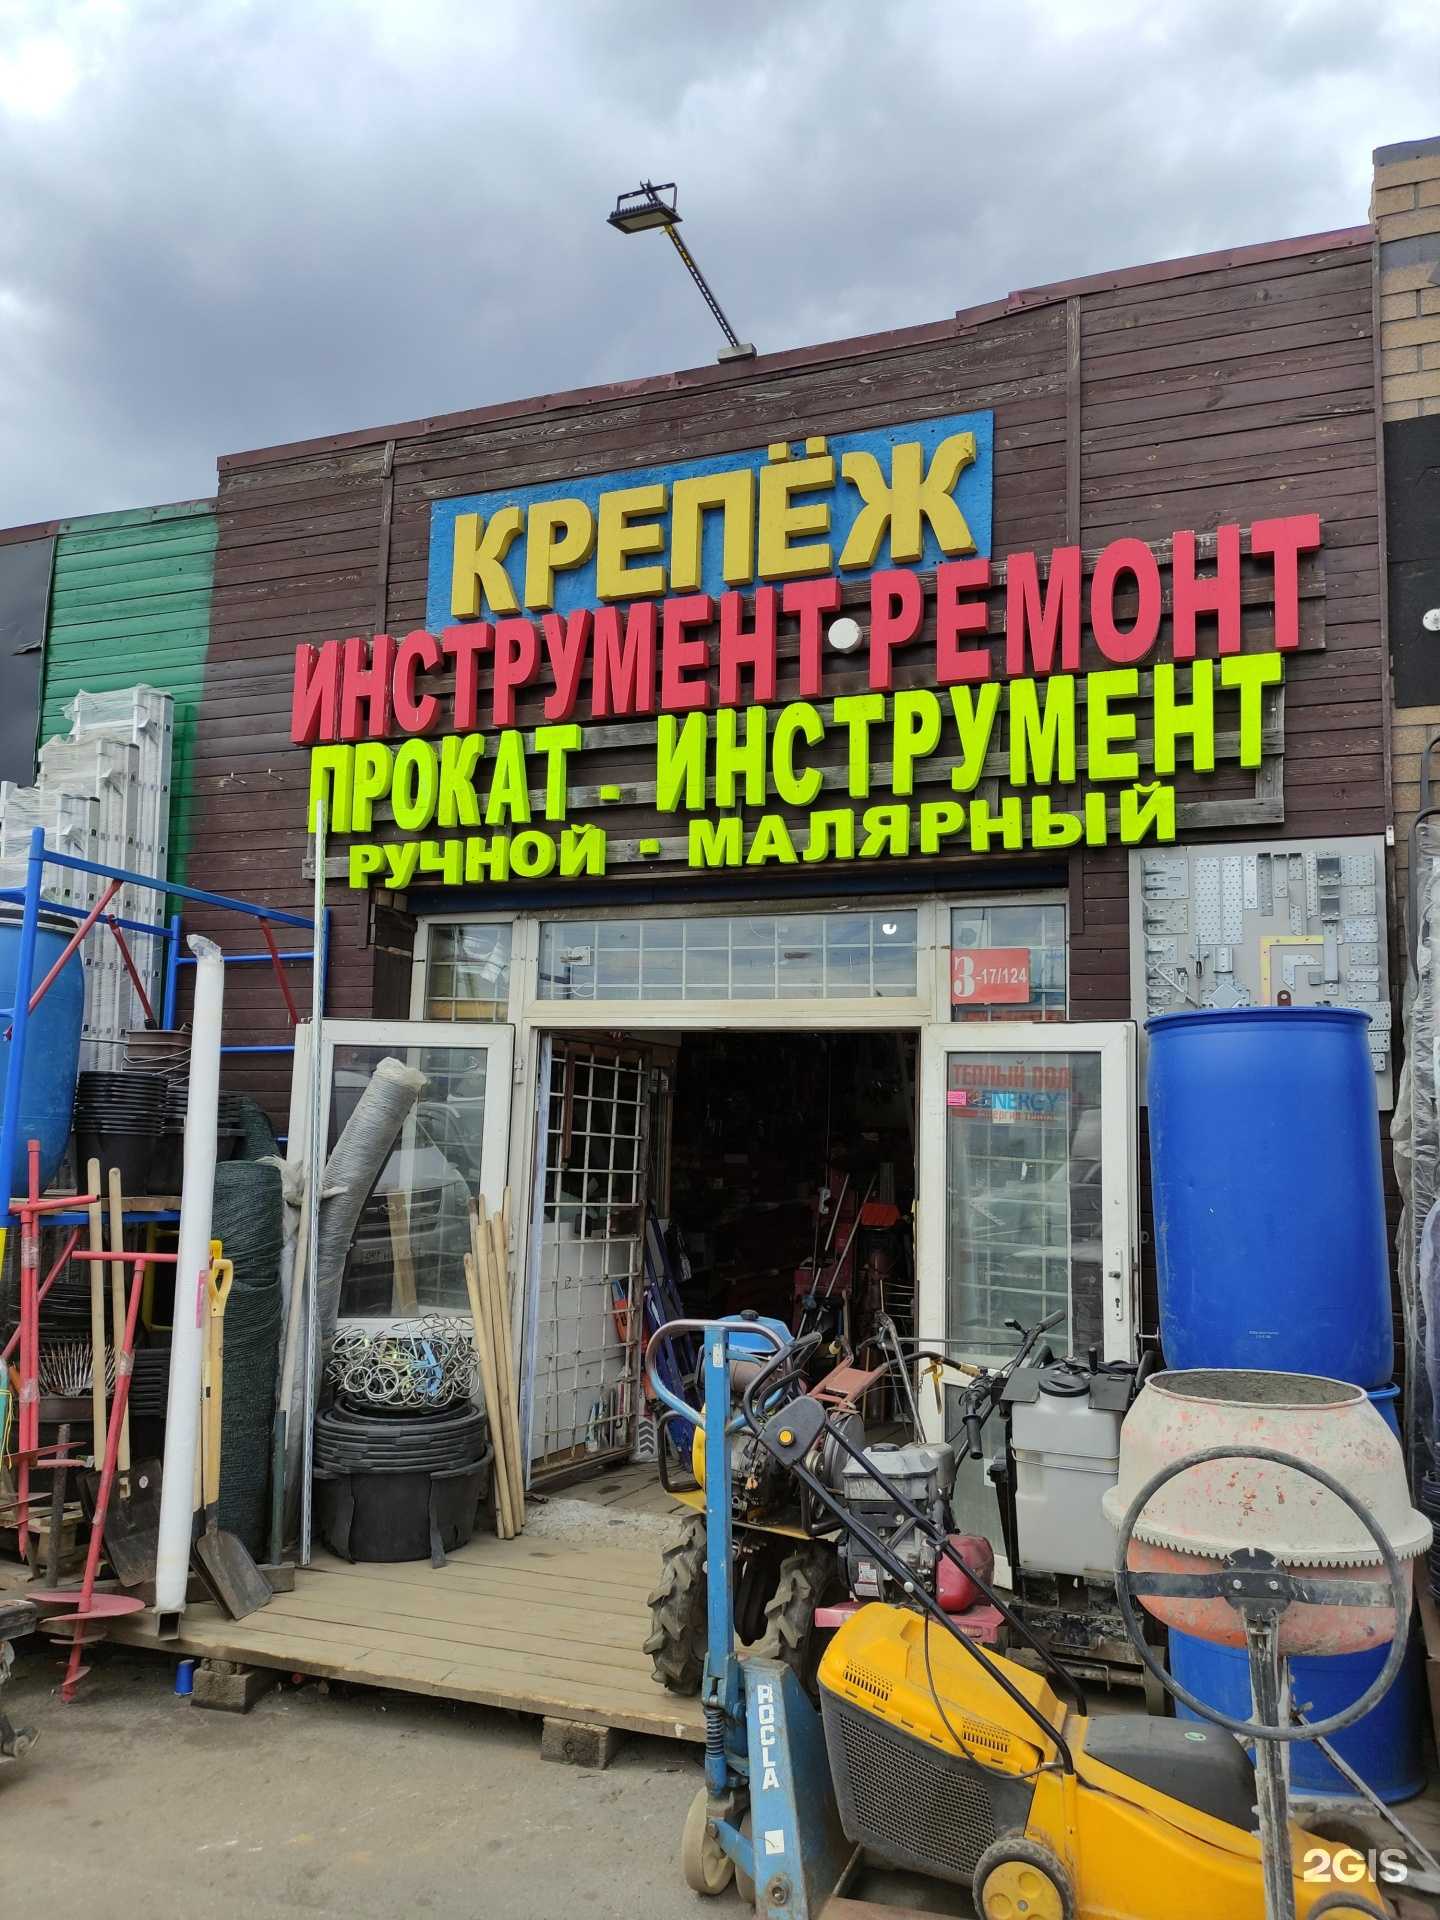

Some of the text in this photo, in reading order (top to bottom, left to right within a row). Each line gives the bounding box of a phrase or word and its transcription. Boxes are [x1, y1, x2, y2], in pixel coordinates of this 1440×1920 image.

[450, 432, 977, 620] КРЕПЁЖ
[290, 513, 1322, 745] ИНСТРУМЕНТ РЕМОНТ
[307, 724, 582, 835] ПРОКАТ
[655, 652, 1282, 814] ИНСТРУМЕНТ
[349, 823, 606, 890] РУЧНОЙ
[688, 781, 1177, 867] МАЛЯРНЫЙ
[757, 1683, 780, 1791] ROCLA
